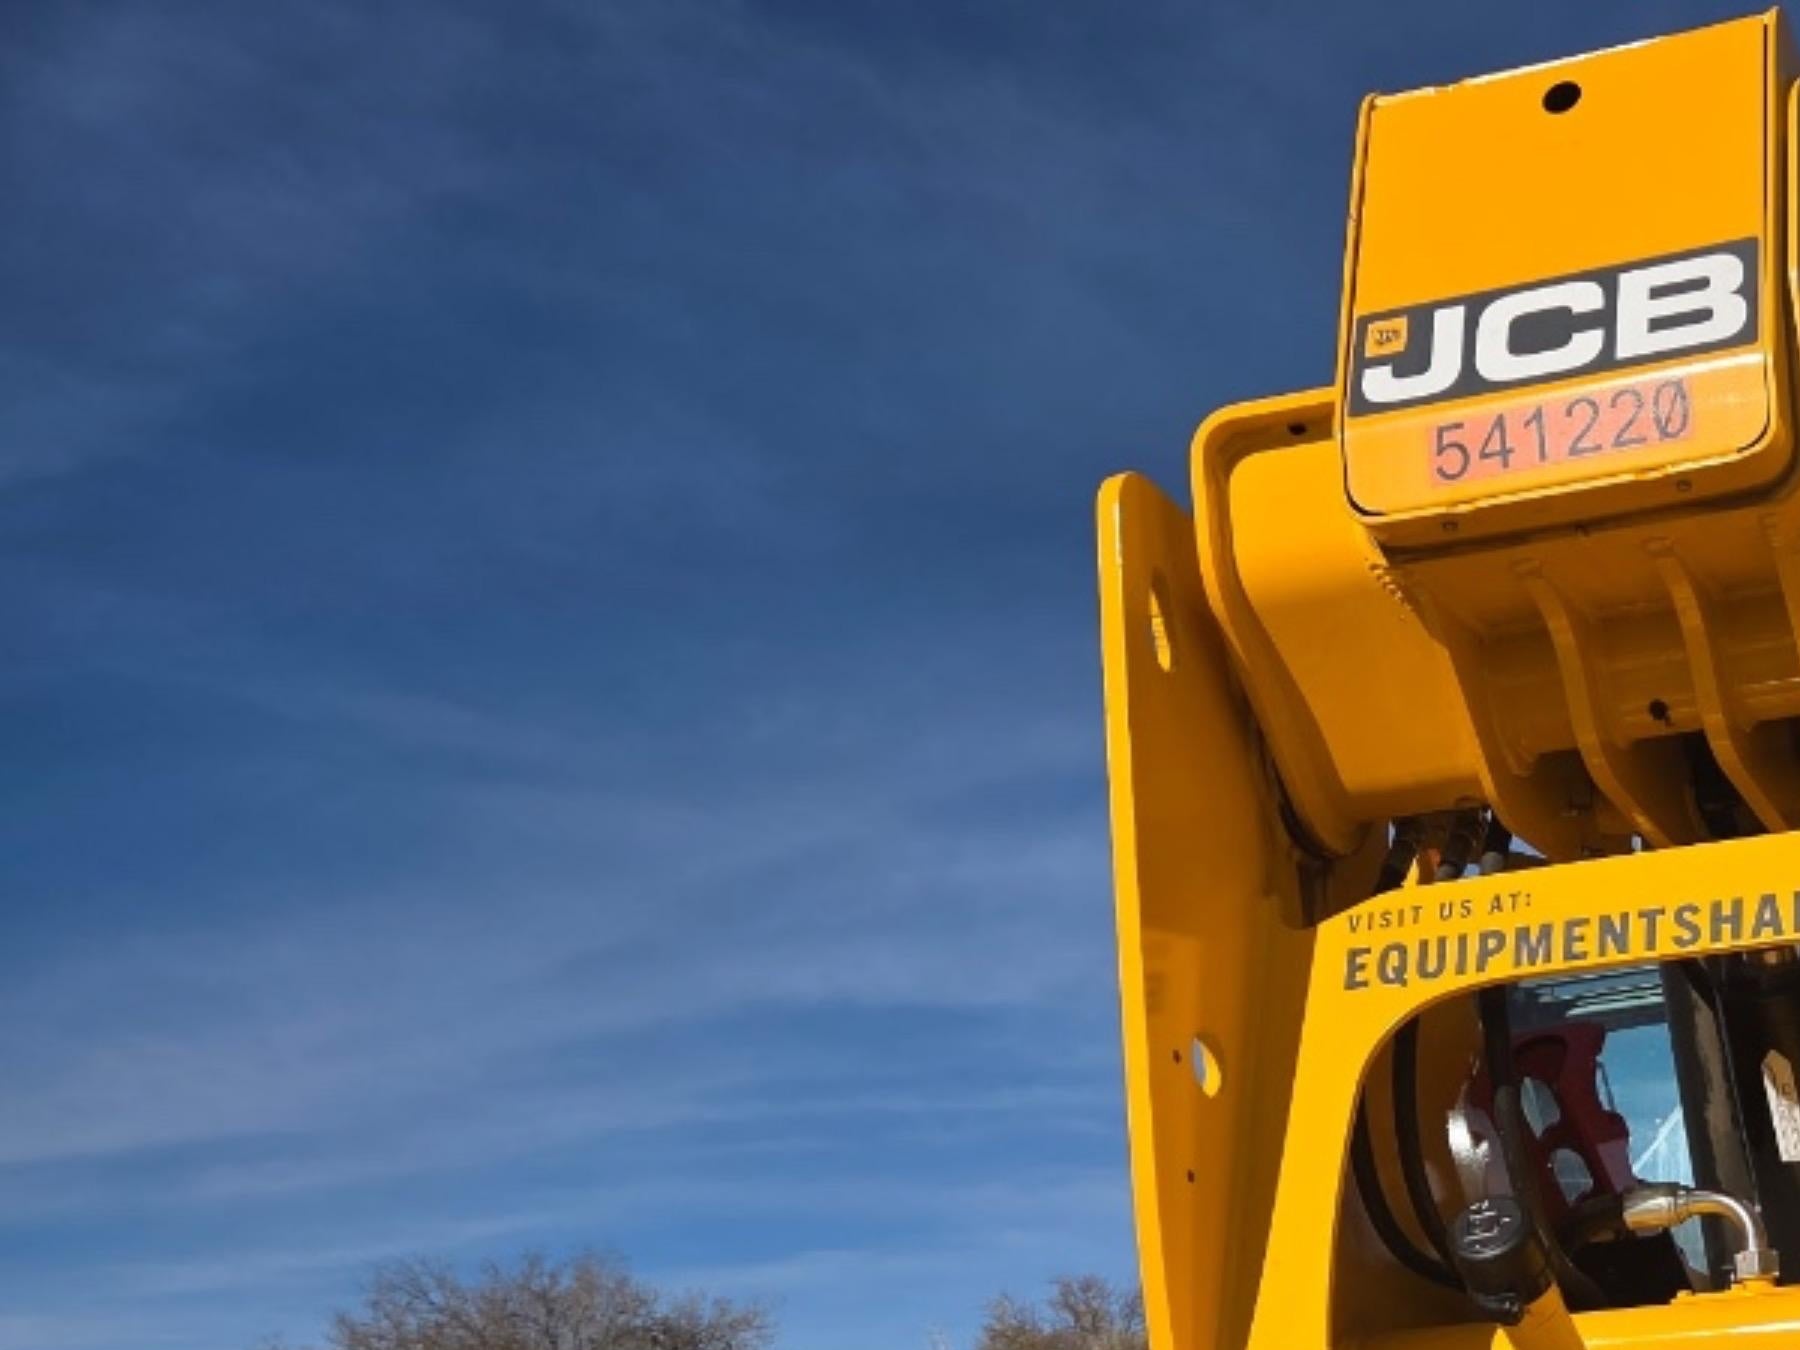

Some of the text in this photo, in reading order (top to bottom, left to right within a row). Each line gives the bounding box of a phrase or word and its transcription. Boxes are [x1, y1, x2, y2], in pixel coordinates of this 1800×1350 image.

[1361, 252, 1748, 403] JCB
[1434, 377, 1691, 482] 541220
[1349, 890, 1532, 934] VISIT US AT:
